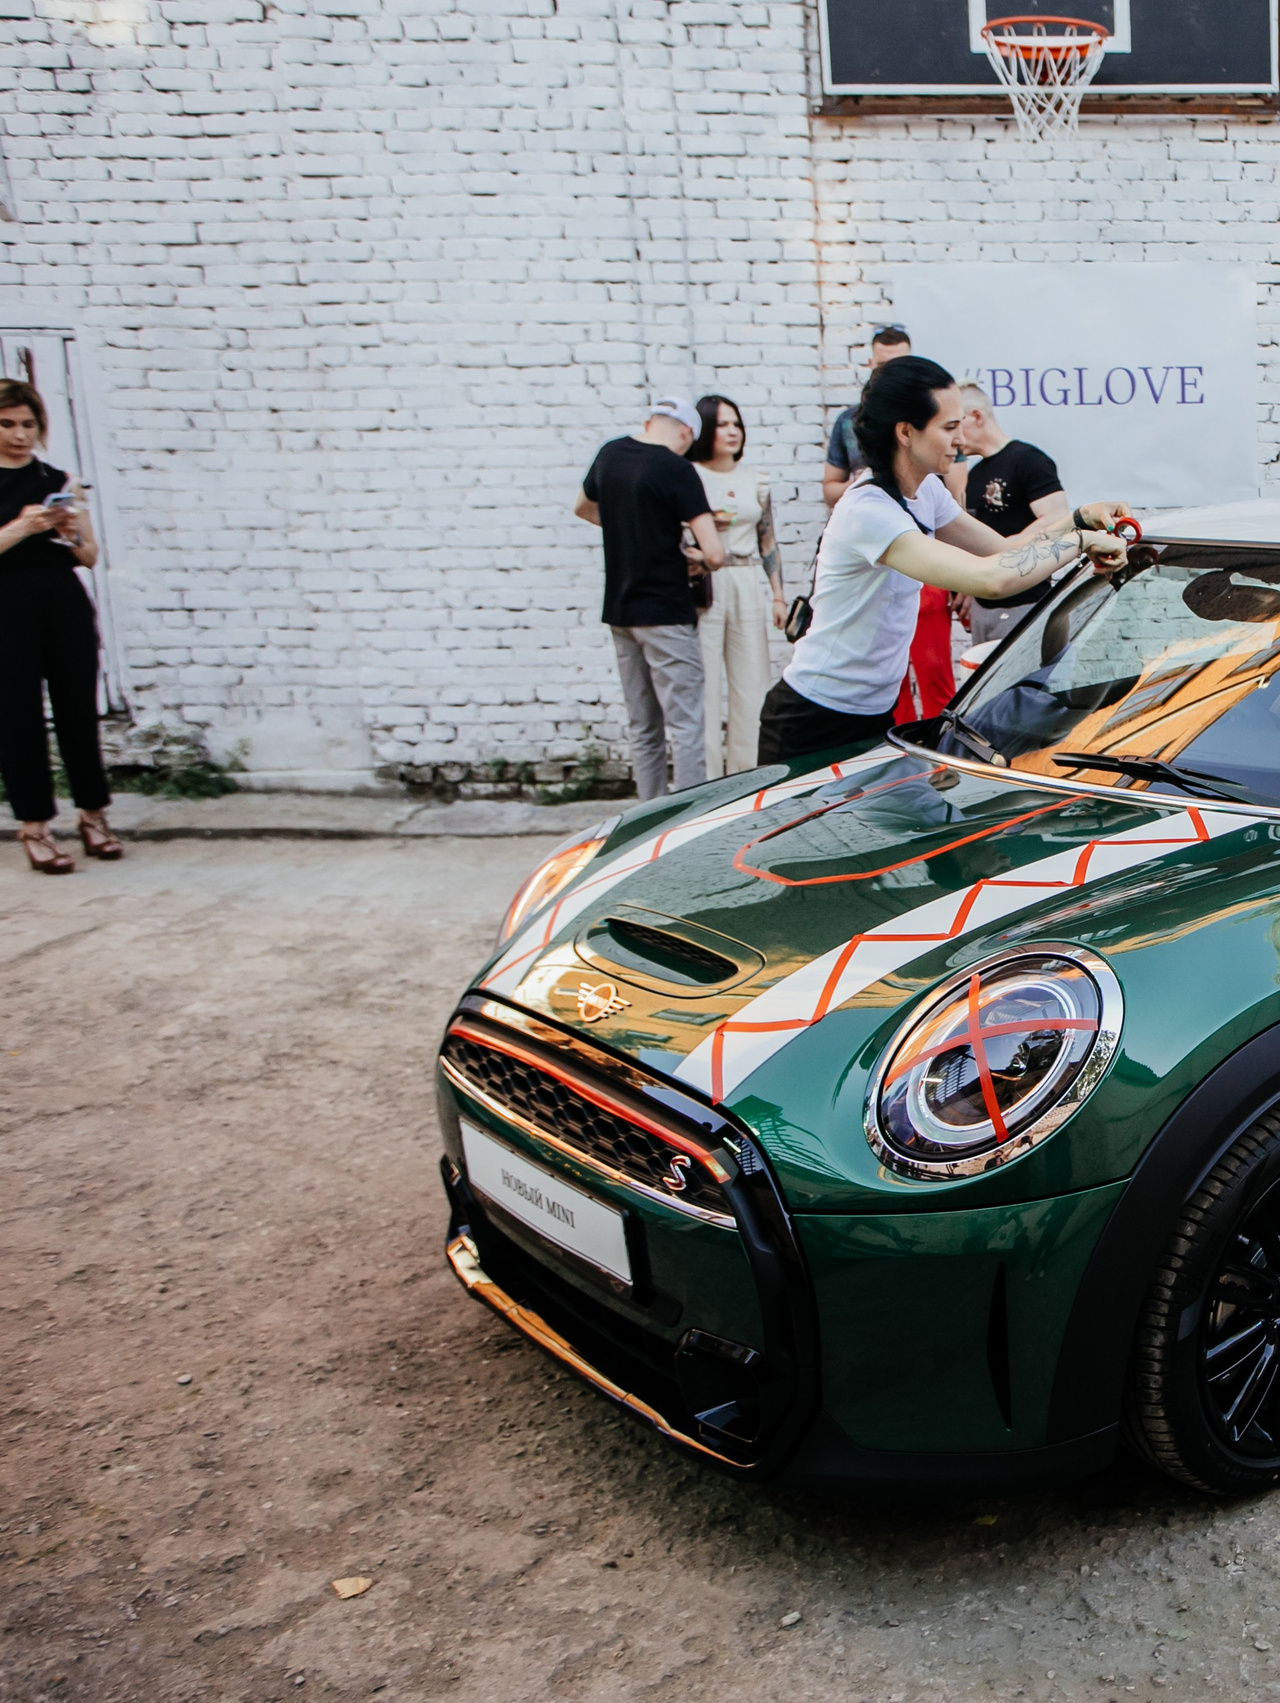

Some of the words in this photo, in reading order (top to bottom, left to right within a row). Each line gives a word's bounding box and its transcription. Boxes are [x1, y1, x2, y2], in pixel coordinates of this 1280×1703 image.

[662, 1155, 691, 1190] S
[501, 1168, 544, 1210] НОВЫЙ
[545, 1196, 576, 1229] MINI
